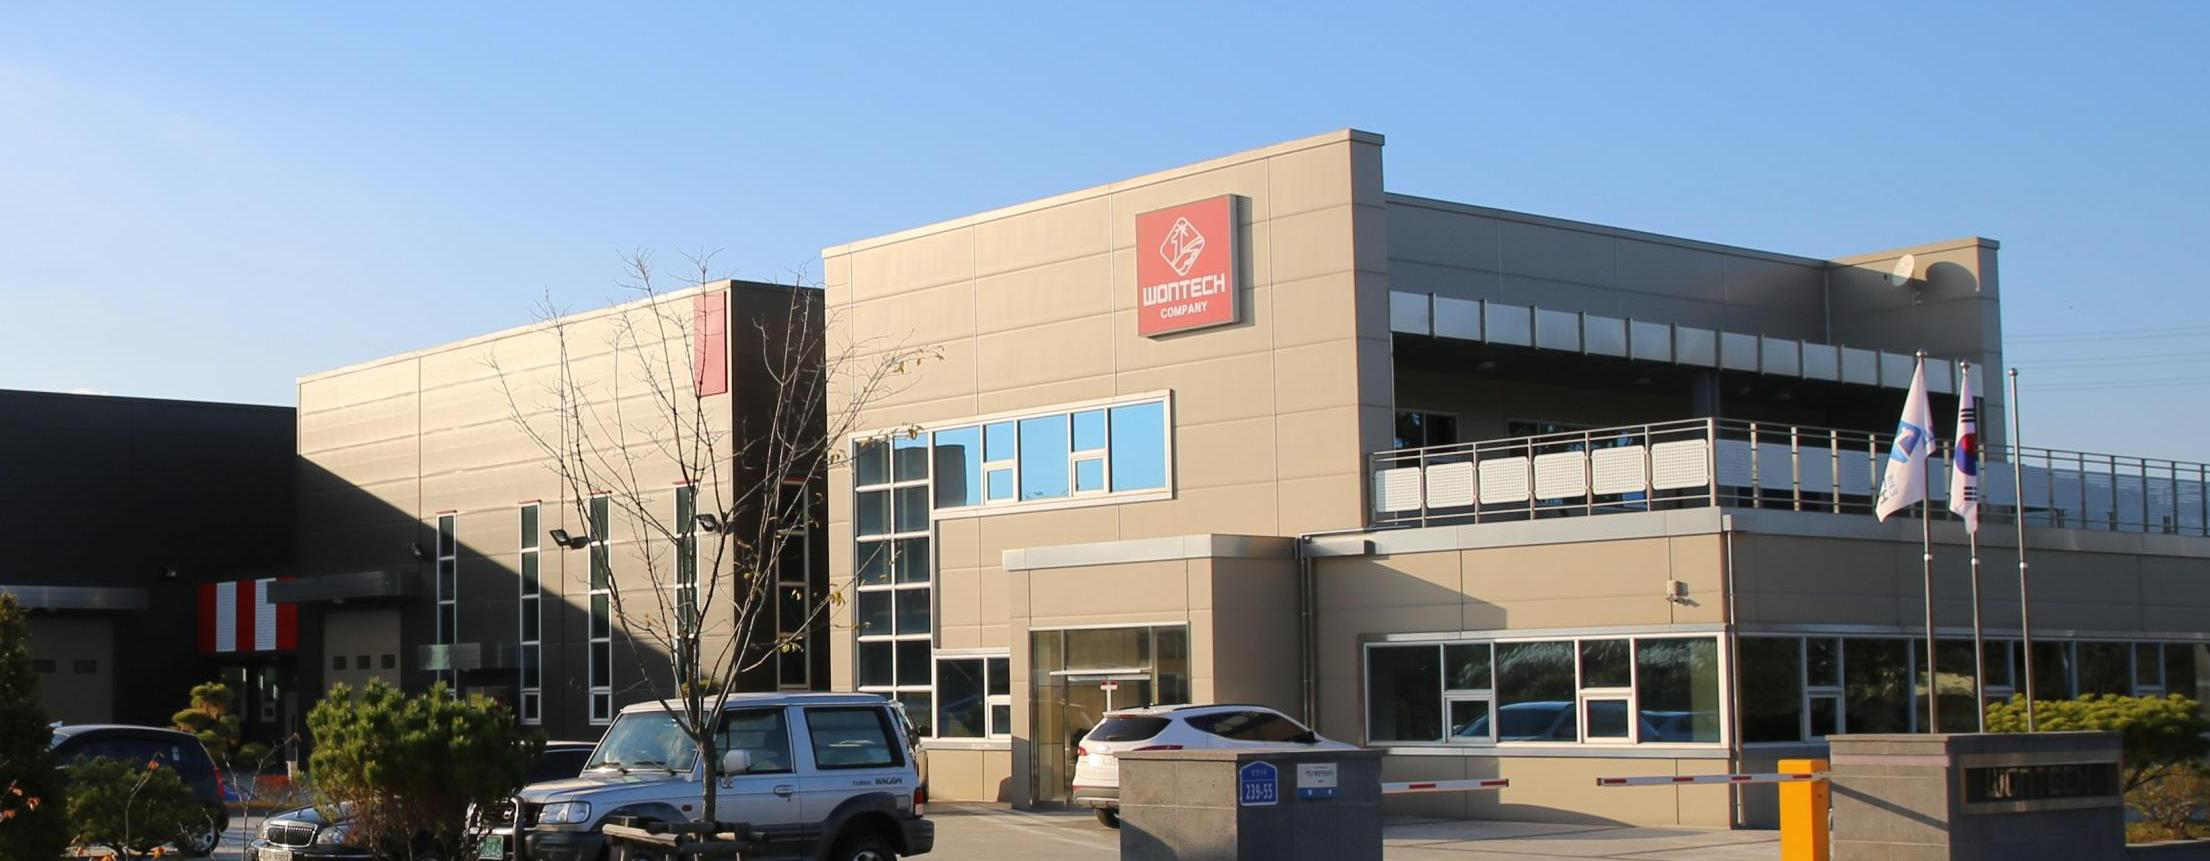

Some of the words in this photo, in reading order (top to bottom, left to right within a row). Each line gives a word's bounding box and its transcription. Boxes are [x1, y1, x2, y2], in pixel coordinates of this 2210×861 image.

[1143, 273, 1226, 306] WONTECH
[1160, 301, 1208, 319] COMPANY
[875, 776, 903, 785] WAGON
[1245, 783, 1273, 800] 239-55
